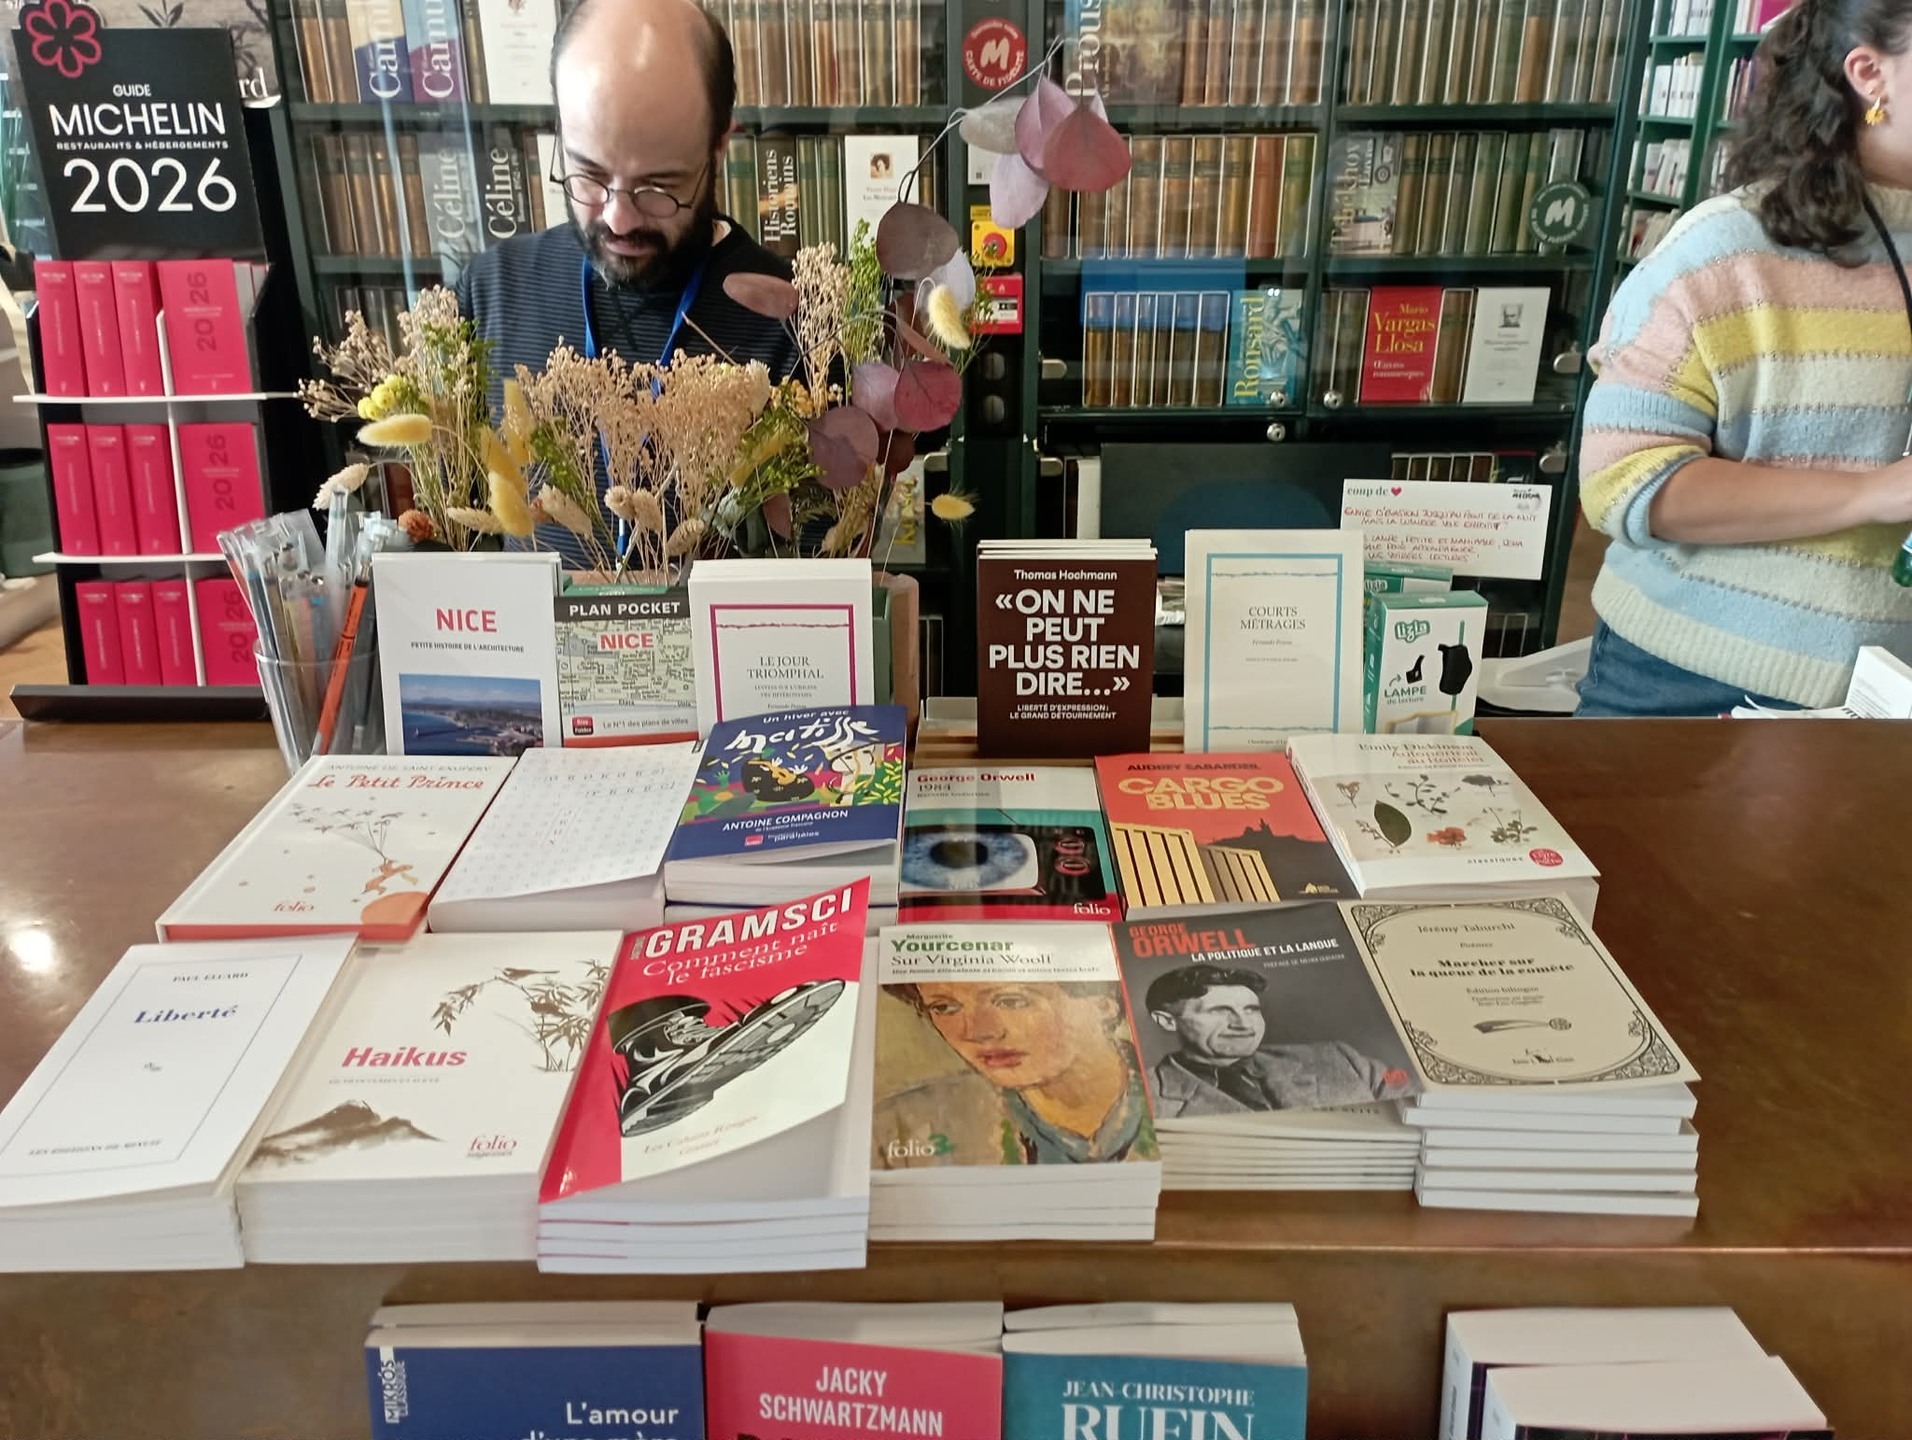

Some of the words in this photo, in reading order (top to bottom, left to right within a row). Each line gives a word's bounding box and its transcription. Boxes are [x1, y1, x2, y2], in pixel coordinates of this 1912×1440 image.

[113, 84, 151, 97] GUIDE
[49, 103, 225, 136] MICHELIN
[56, 141, 132, 150] RESTAURANTS
[145, 140, 228, 149] HÉBERGEMENTS
[63, 157, 237, 213] 2026
[433, 147, 465, 238] Céline
[485, 148, 517, 238] Céline
[763, 149, 781, 242] Historiens
[1400, 304, 1428, 314] Mario
[1374, 312, 1436, 338] Vargas
[1233, 296, 1265, 398] Ronsard
[1375, 334, 1423, 354] Llosa
[1347, 487, 1373, 497] coup
[1014, 569, 1057, 580] Thomas
[1059, 569, 1118, 580] Hochmann
[570, 603, 612, 617] PLAN
[618, 601, 680, 616] POCKET
[1073, 589, 1115, 614] NE
[436, 608, 497, 633] NICE
[1248, 606, 1298, 617] COURTS
[1026, 617, 1105, 642] PEUT
[1240, 618, 1306, 630] MÉTRAGES
[434, 642, 462, 650] HISTOIRE
[600, 633, 654, 650] NICE
[760, 656, 774, 666] LE
[777, 656, 810, 668] JOUR
[989, 645, 1064, 669] PLUS
[1071, 645, 1140, 669] RIEN
[747, 668, 824, 679] TRIOMPHAL
[1384, 686, 1427, 698] LAMPE
[1017, 702, 1048, 712] LIBERTÉ
[1051, 711, 1117, 719] DÉTOURNEMENT
[641, 719, 659, 728] plans
[763, 716, 779, 724] Un
[784, 712, 817, 721] hiver
[346, 774, 400, 788] Petit
[406, 774, 484, 788] Prince
[917, 774, 975, 783] George
[980, 773, 1035, 781] Orwell
[1118, 777, 1284, 795] CARGO
[1145, 792, 1271, 810] BLUES
[722, 818, 773, 832] ANTOINE
[776, 810, 848, 825] COMPAGNON
[271, 900, 315, 912] folio
[1073, 903, 1111, 915] folio
[644, 887, 852, 958] GRAMSCI
[1129, 922, 1187, 938] GEORGE
[643, 938, 781, 976] Comment
[791, 921, 838, 945] naît
[891, 939, 1014, 952] Yourcenar
[1132, 928, 1256, 958] ORWELL
[1191, 953, 1206, 963] LA
[1208, 948, 1262, 962] POLITIQUE
[1264, 946, 1276, 956] ET
[1279, 944, 1294, 954] LA
[1296, 938, 1339, 952] LANGUE
[668, 970, 689, 985] le
[701, 944, 808, 979] fascisme
[891, 955, 921, 965] Sur
[926, 954, 994, 967] Virginia
[1000, 953, 1053, 965] Woolf
[1410, 969, 1426, 977] la
[1478, 968, 1496, 976] de
[134, 1004, 239, 1024] Liberté
[342, 1046, 468, 1067] Haikus
[470, 1134, 518, 1151] folio
[888, 1138, 935, 1159] folio
[377, 1359, 398, 1421] MIKRÓS
[816, 1366, 887, 1397] JACKY
[567, 1402, 679, 1425] L'amour
[759, 1393, 943, 1437] SCHWARTZMANN
[1061, 1403, 1255, 1440] RUFIN
